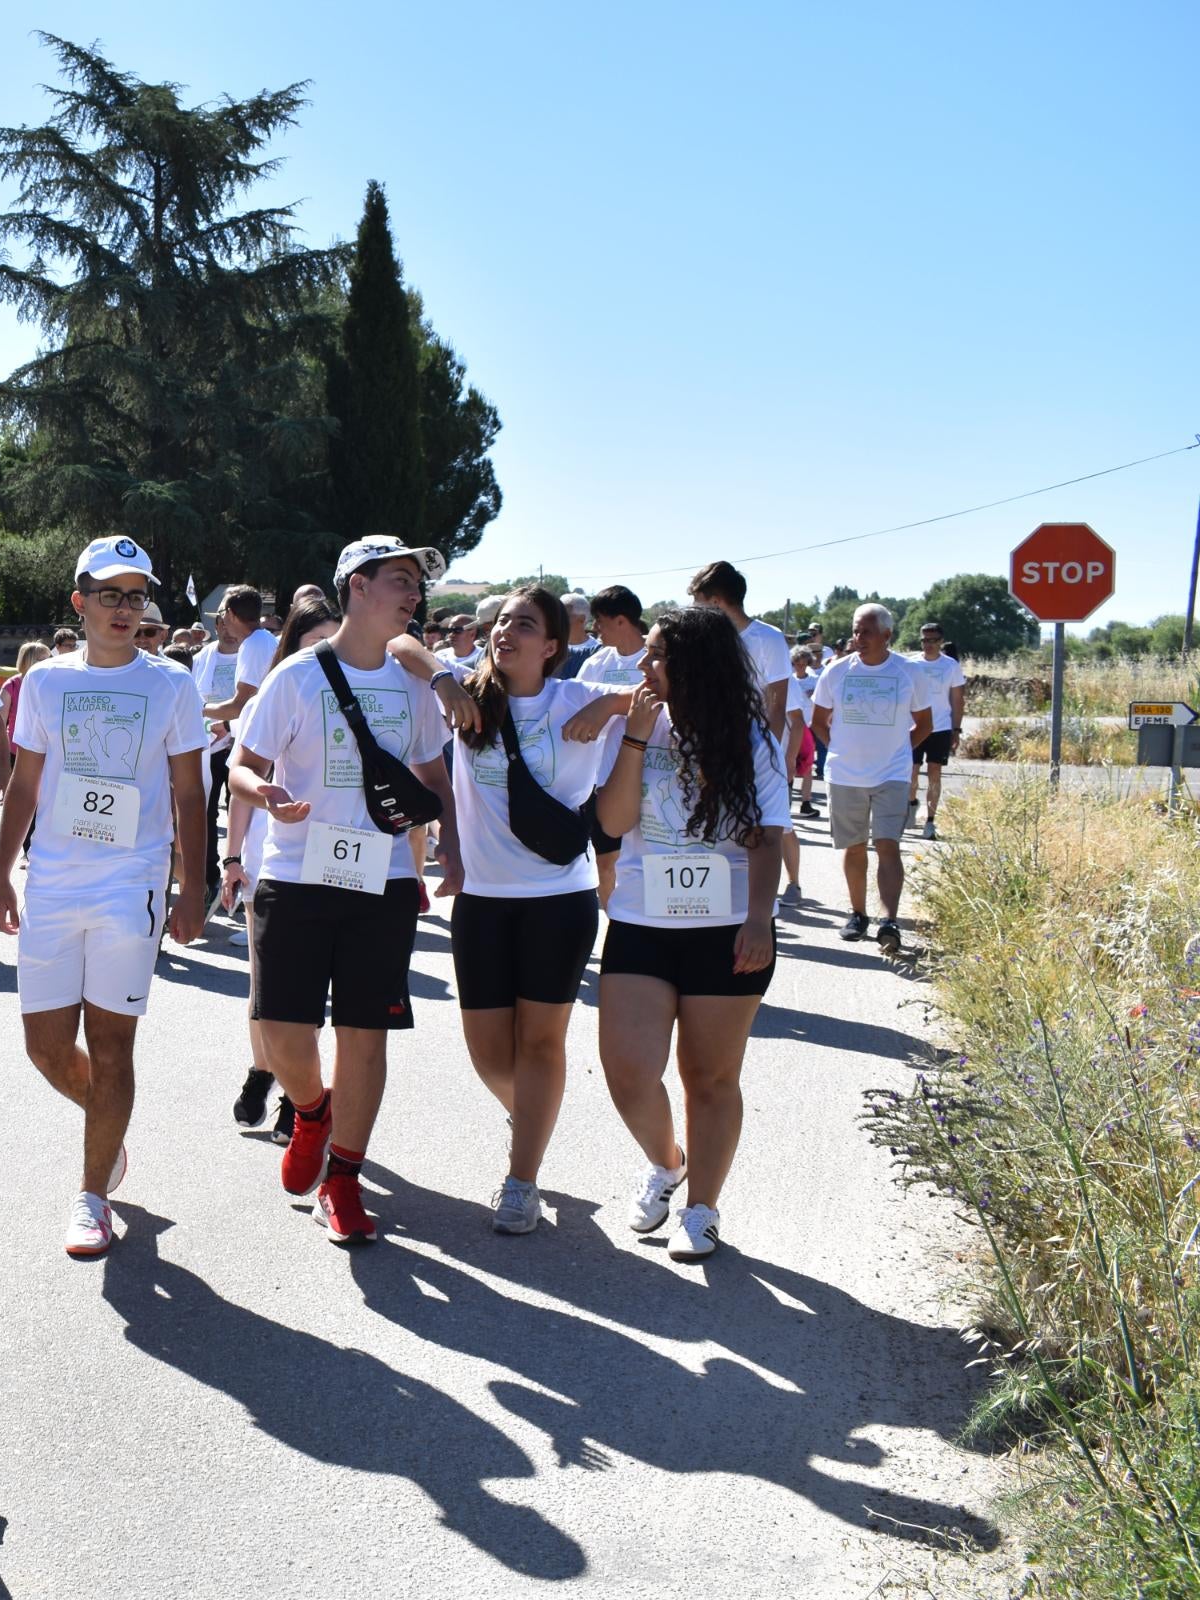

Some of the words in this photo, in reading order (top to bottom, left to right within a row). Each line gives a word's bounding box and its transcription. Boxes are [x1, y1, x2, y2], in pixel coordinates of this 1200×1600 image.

[1021, 562, 1104, 584] STOP
[67, 697, 76, 705] IX
[80, 696, 111, 704] PASEO
[67, 703, 117, 713] SALUDABLE
[327, 695, 337, 705] IX
[83, 791, 115, 816] 82
[333, 839, 362, 863] 61
[665, 867, 710, 888] 107
